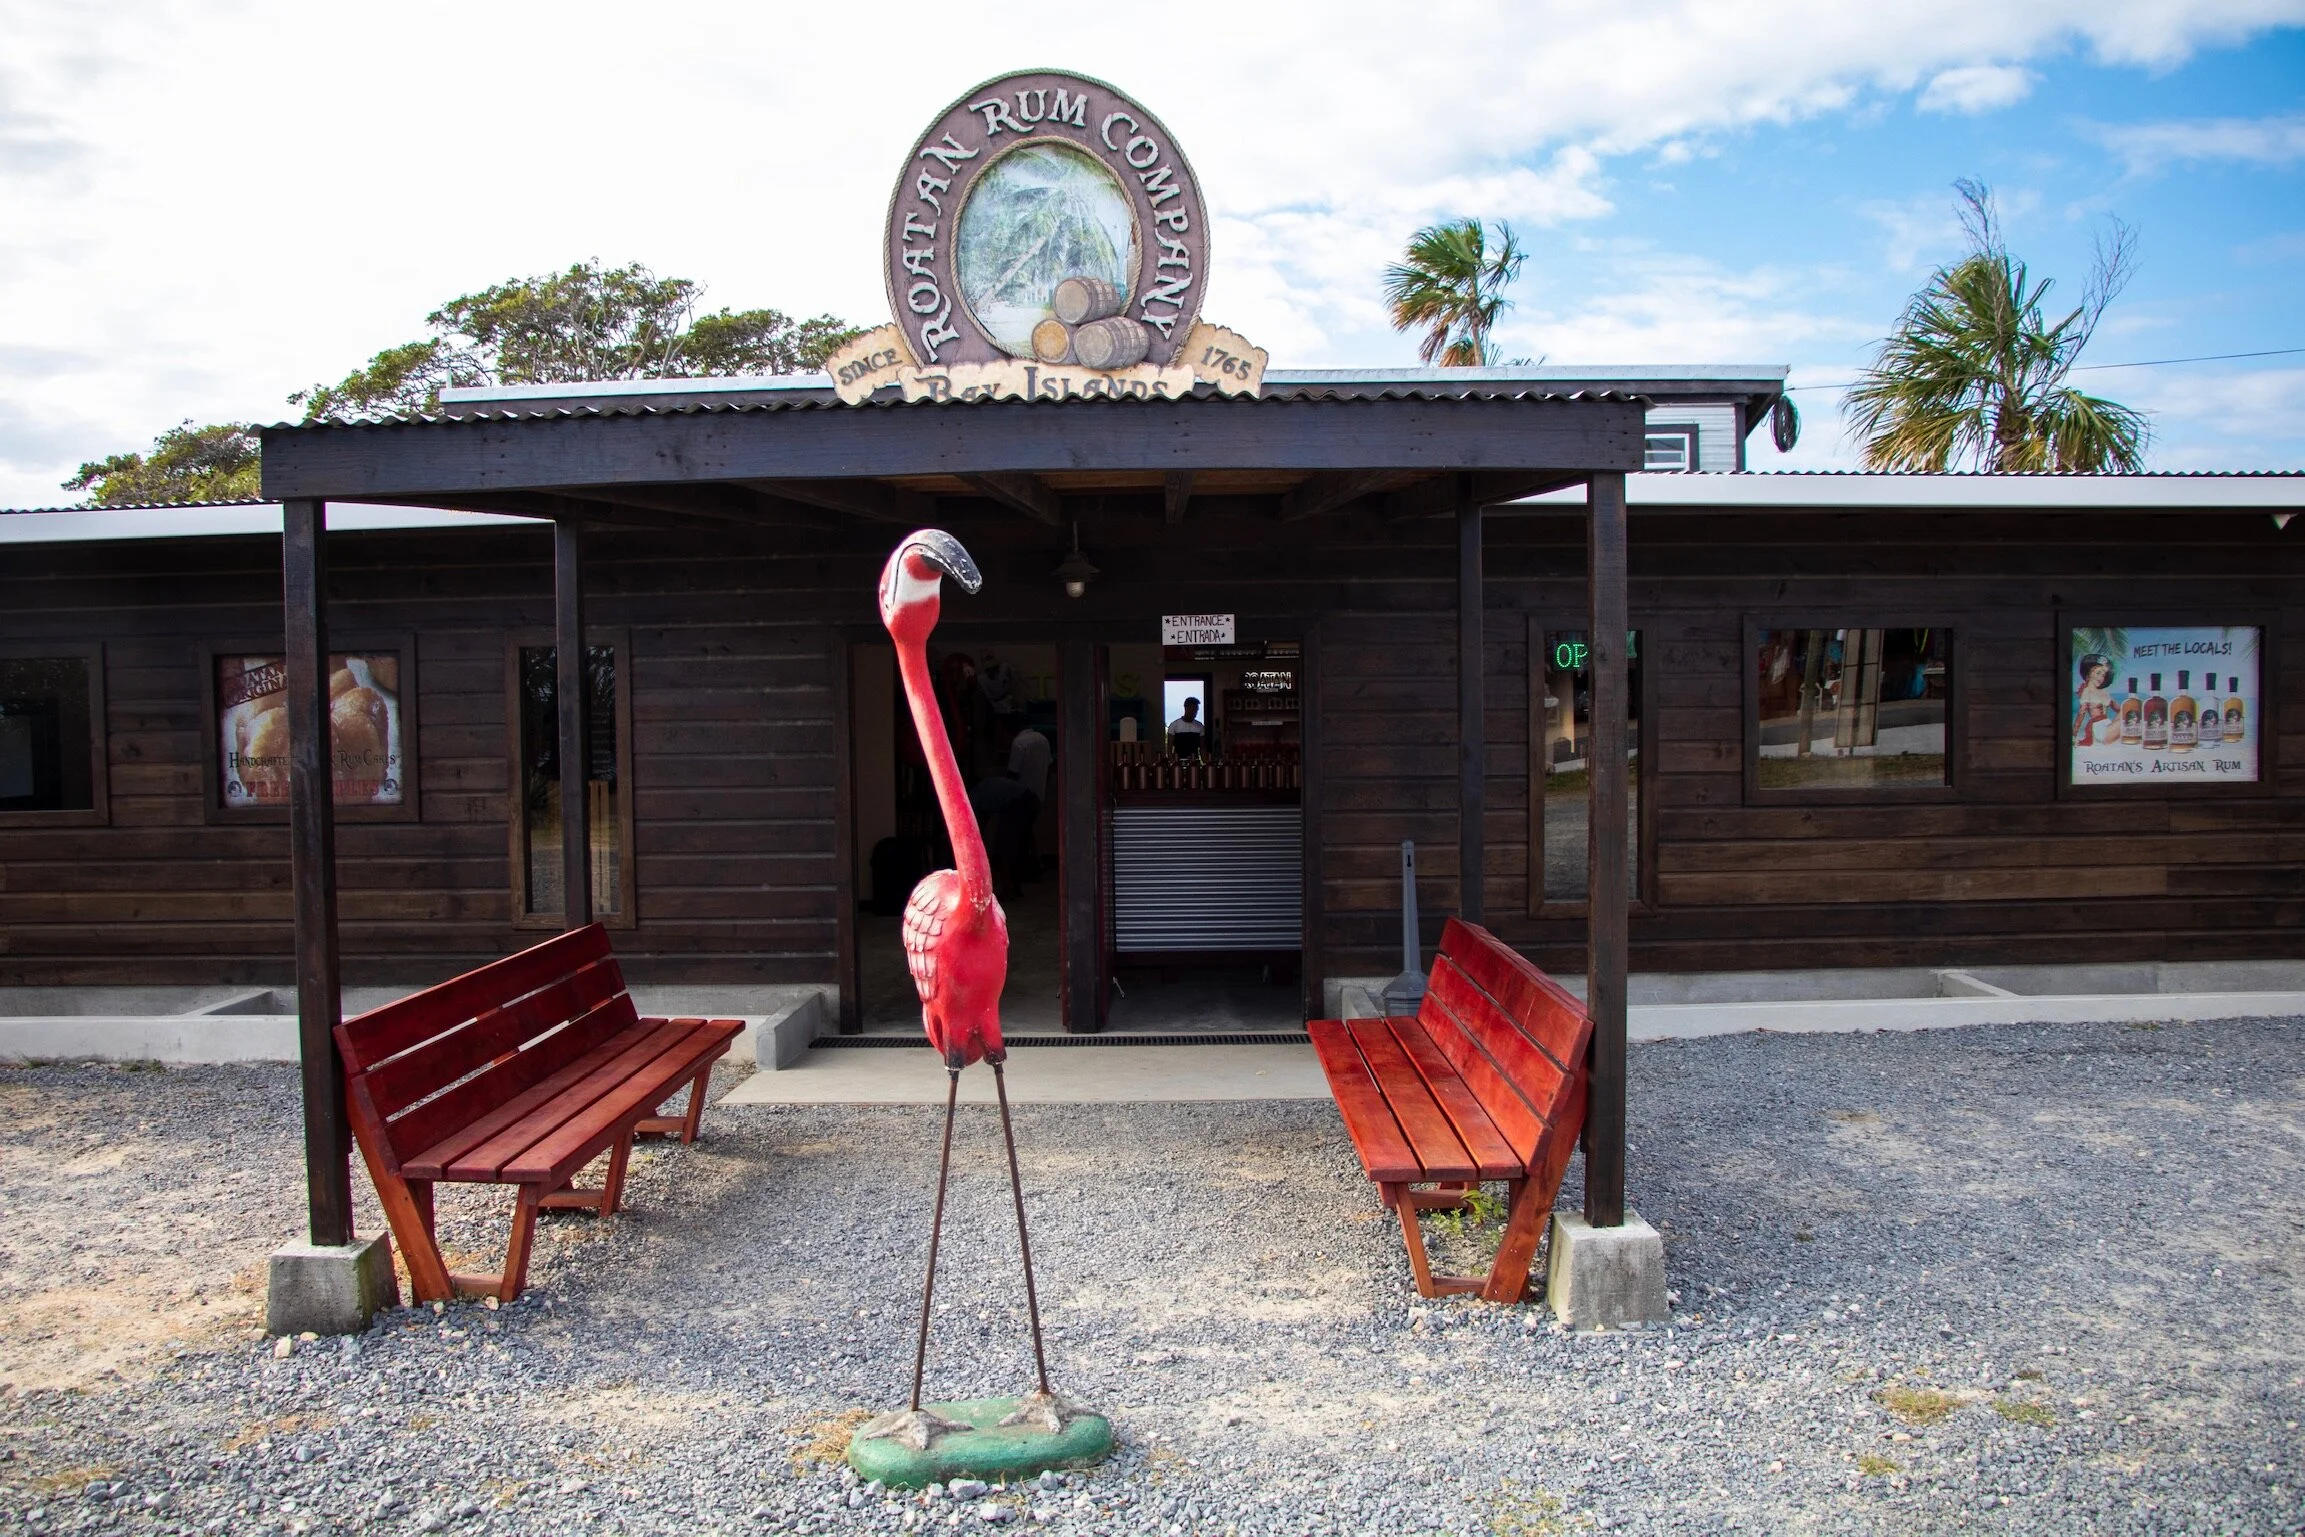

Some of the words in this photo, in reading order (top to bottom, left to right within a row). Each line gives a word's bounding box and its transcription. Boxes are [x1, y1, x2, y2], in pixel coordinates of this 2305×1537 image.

[901, 132, 979, 364] ROATAN
[968, 88, 1089, 136] RUM
[1100, 111, 1192, 340] COMPANY
[837, 348, 902, 386] SINCE
[1201, 345, 1253, 381] 1765
[1024, 366, 1169, 400] ISLANDS
[1172, 614, 1224, 627] ENTRANCE
[1177, 629, 1221, 643] ENTRADA
[1555, 642, 1589, 669] OP
[2133, 643, 2160, 659] MEET
[2163, 642, 2182, 656] THE
[2184, 641, 2233, 656] LOCALS!
[229, 752, 290, 769] HANDCRAFTE
[2083, 759, 2143, 775] ROATAN'S
[2151, 759, 2206, 774] ARTISAN
[2212, 758, 2242, 772] RUM
